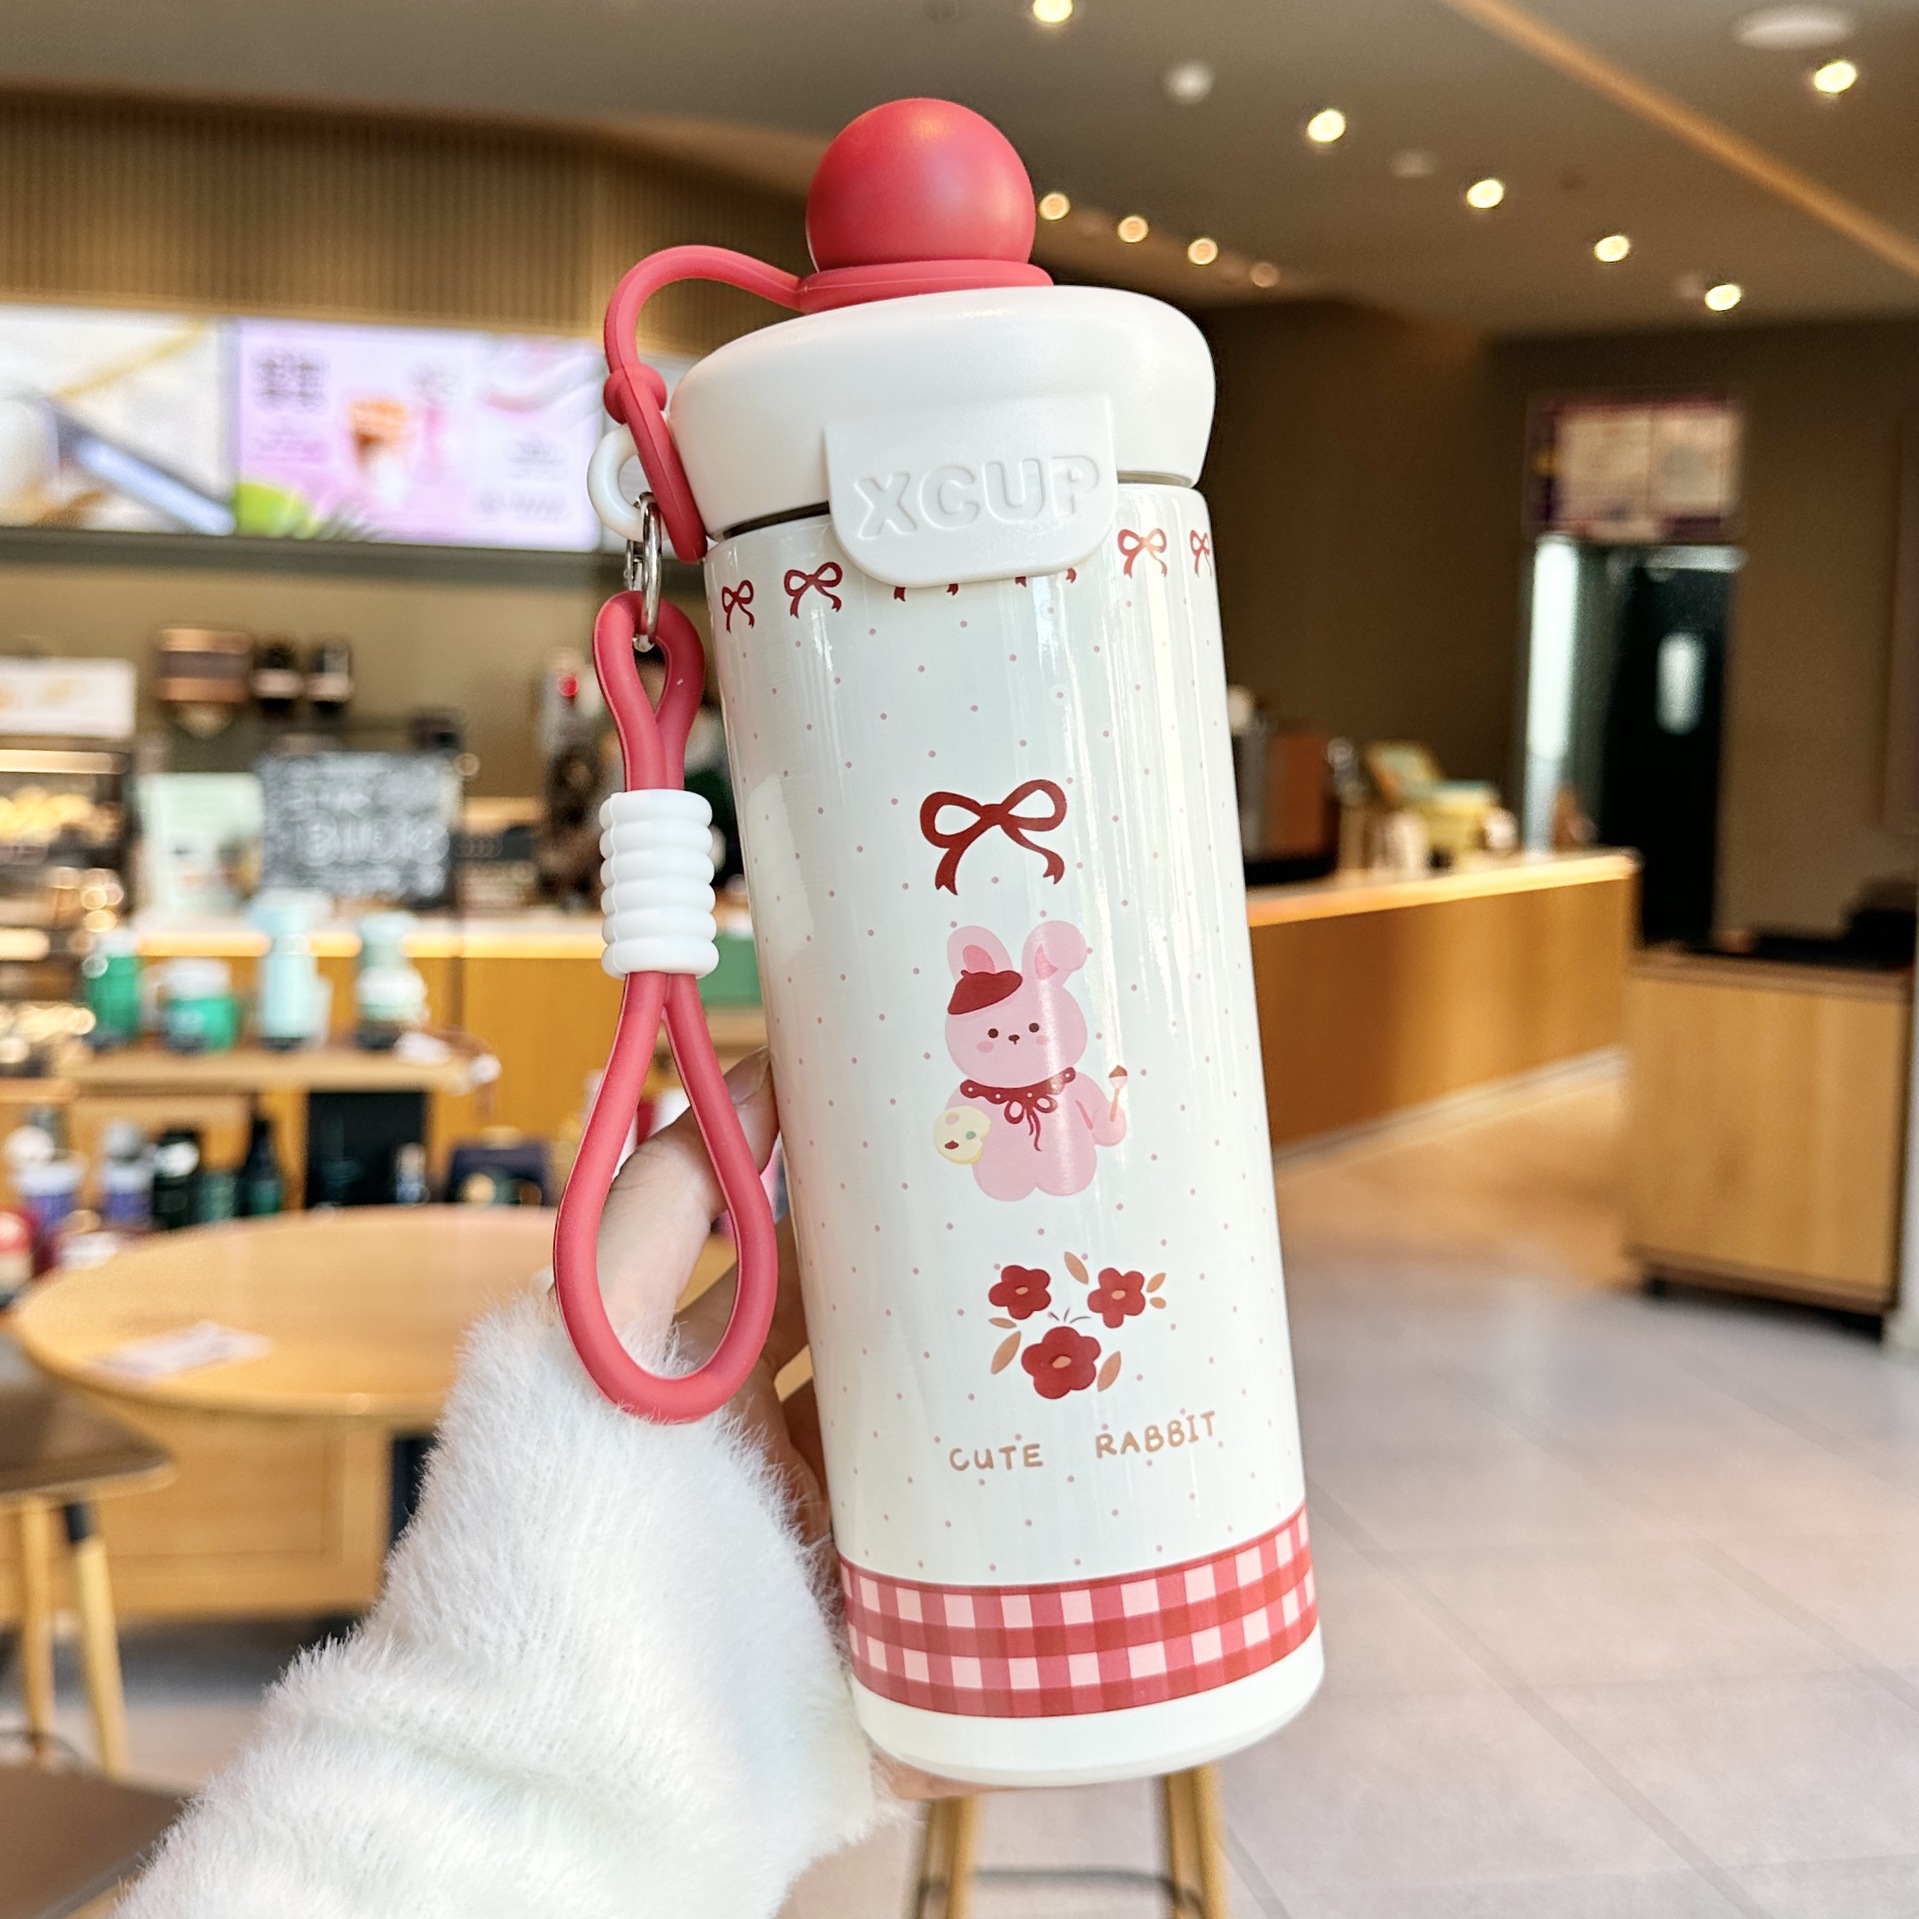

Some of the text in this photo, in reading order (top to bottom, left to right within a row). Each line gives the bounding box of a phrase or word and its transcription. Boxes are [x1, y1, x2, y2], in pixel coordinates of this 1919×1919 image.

[853, 455, 1100, 540] XCUP
[949, 1410, 1216, 1471] CUTE RABBIT
